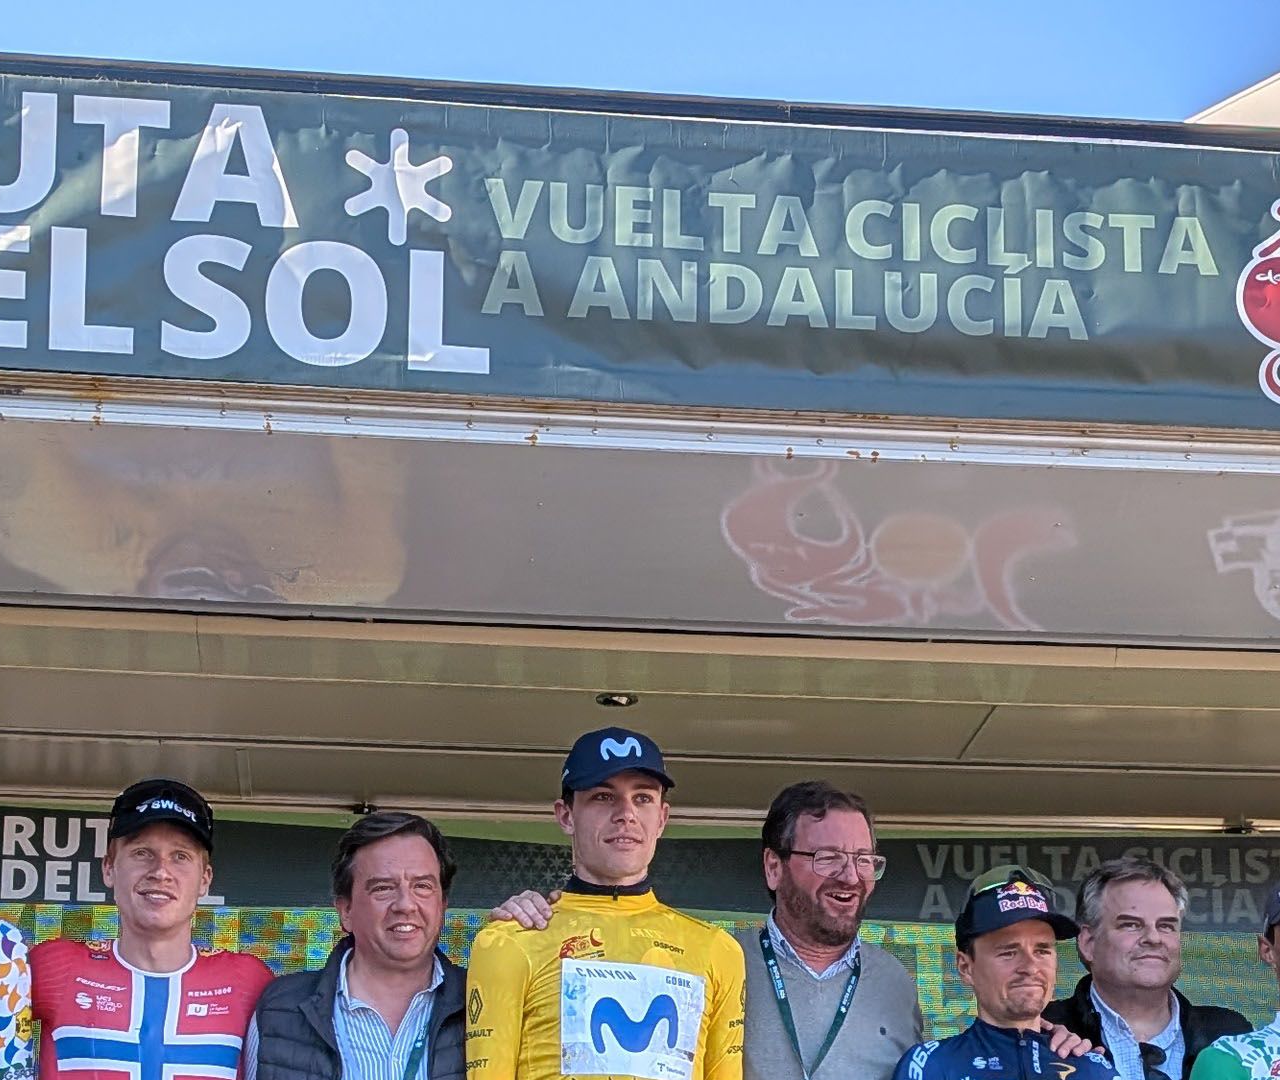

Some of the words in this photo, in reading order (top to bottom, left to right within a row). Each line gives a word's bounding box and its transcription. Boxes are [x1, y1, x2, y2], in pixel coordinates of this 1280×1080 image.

[484, 177, 818, 258] VUELTA
[846, 198, 1218, 277] CICLISTA
[160, 233, 492, 375] SOL
[481, 250, 544, 318] A
[567, 254, 1091, 342] ANDALUCÍA
[2, 816, 111, 858] RUT
[0, 859, 105, 902] DEL
[1000, 896, 1026, 912] Red
[653, 941, 685, 955] GSPORT
[576, 967, 637, 981] CANYON
[665, 975, 691, 988] GOBIK
